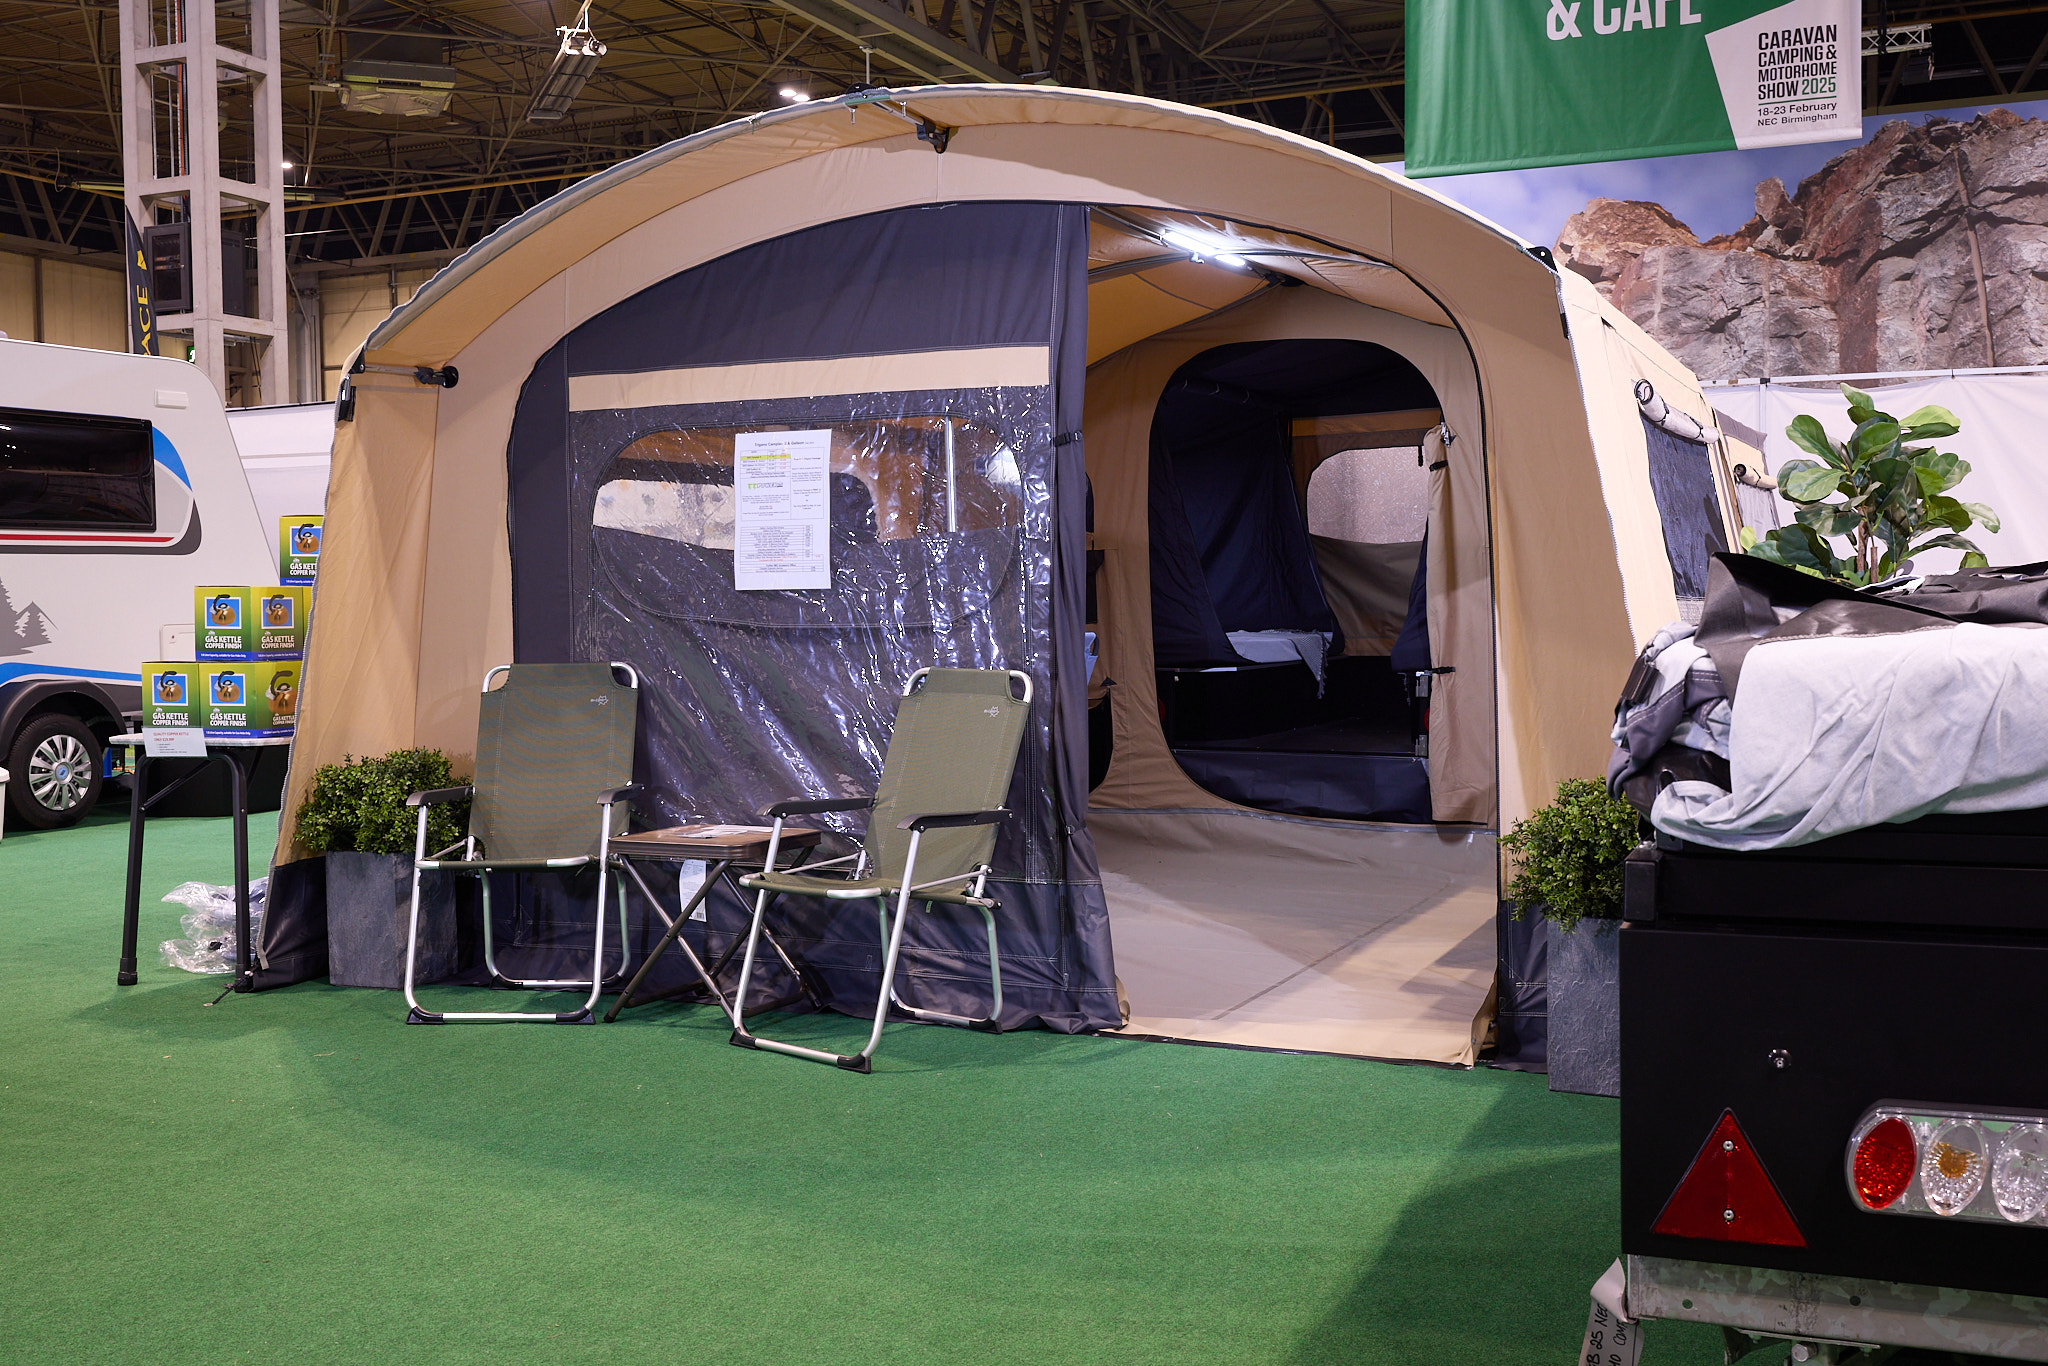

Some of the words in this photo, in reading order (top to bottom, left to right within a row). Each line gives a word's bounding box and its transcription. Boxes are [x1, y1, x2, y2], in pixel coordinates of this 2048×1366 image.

[1546, 0, 1583, 41] &
[1758, 24, 1837, 51] CARAVAN
[1758, 45, 1824, 68] CAMPING
[1825, 44, 1837, 60] &
[1758, 61, 1837, 83] MOTORHOME
[1758, 80, 1799, 101] SHOW
[1801, 76, 1836, 96] 2025
[1757, 105, 1787, 117] 18-23
[1789, 102, 1837, 114] February
[1757, 117, 1778, 127] NEC
[1781, 113, 1838, 124] Birmingham
[205, 635, 218, 643] GAS
[218, 635, 242, 643] KETTLE
[272, 635, 294, 643] KETTLE
[152, 712, 165, 720] GAS
[166, 712, 188, 720] KETTLE
[224, 713, 246, 721] KETTLE
[1590, 1330, 1604, 1350] 25
